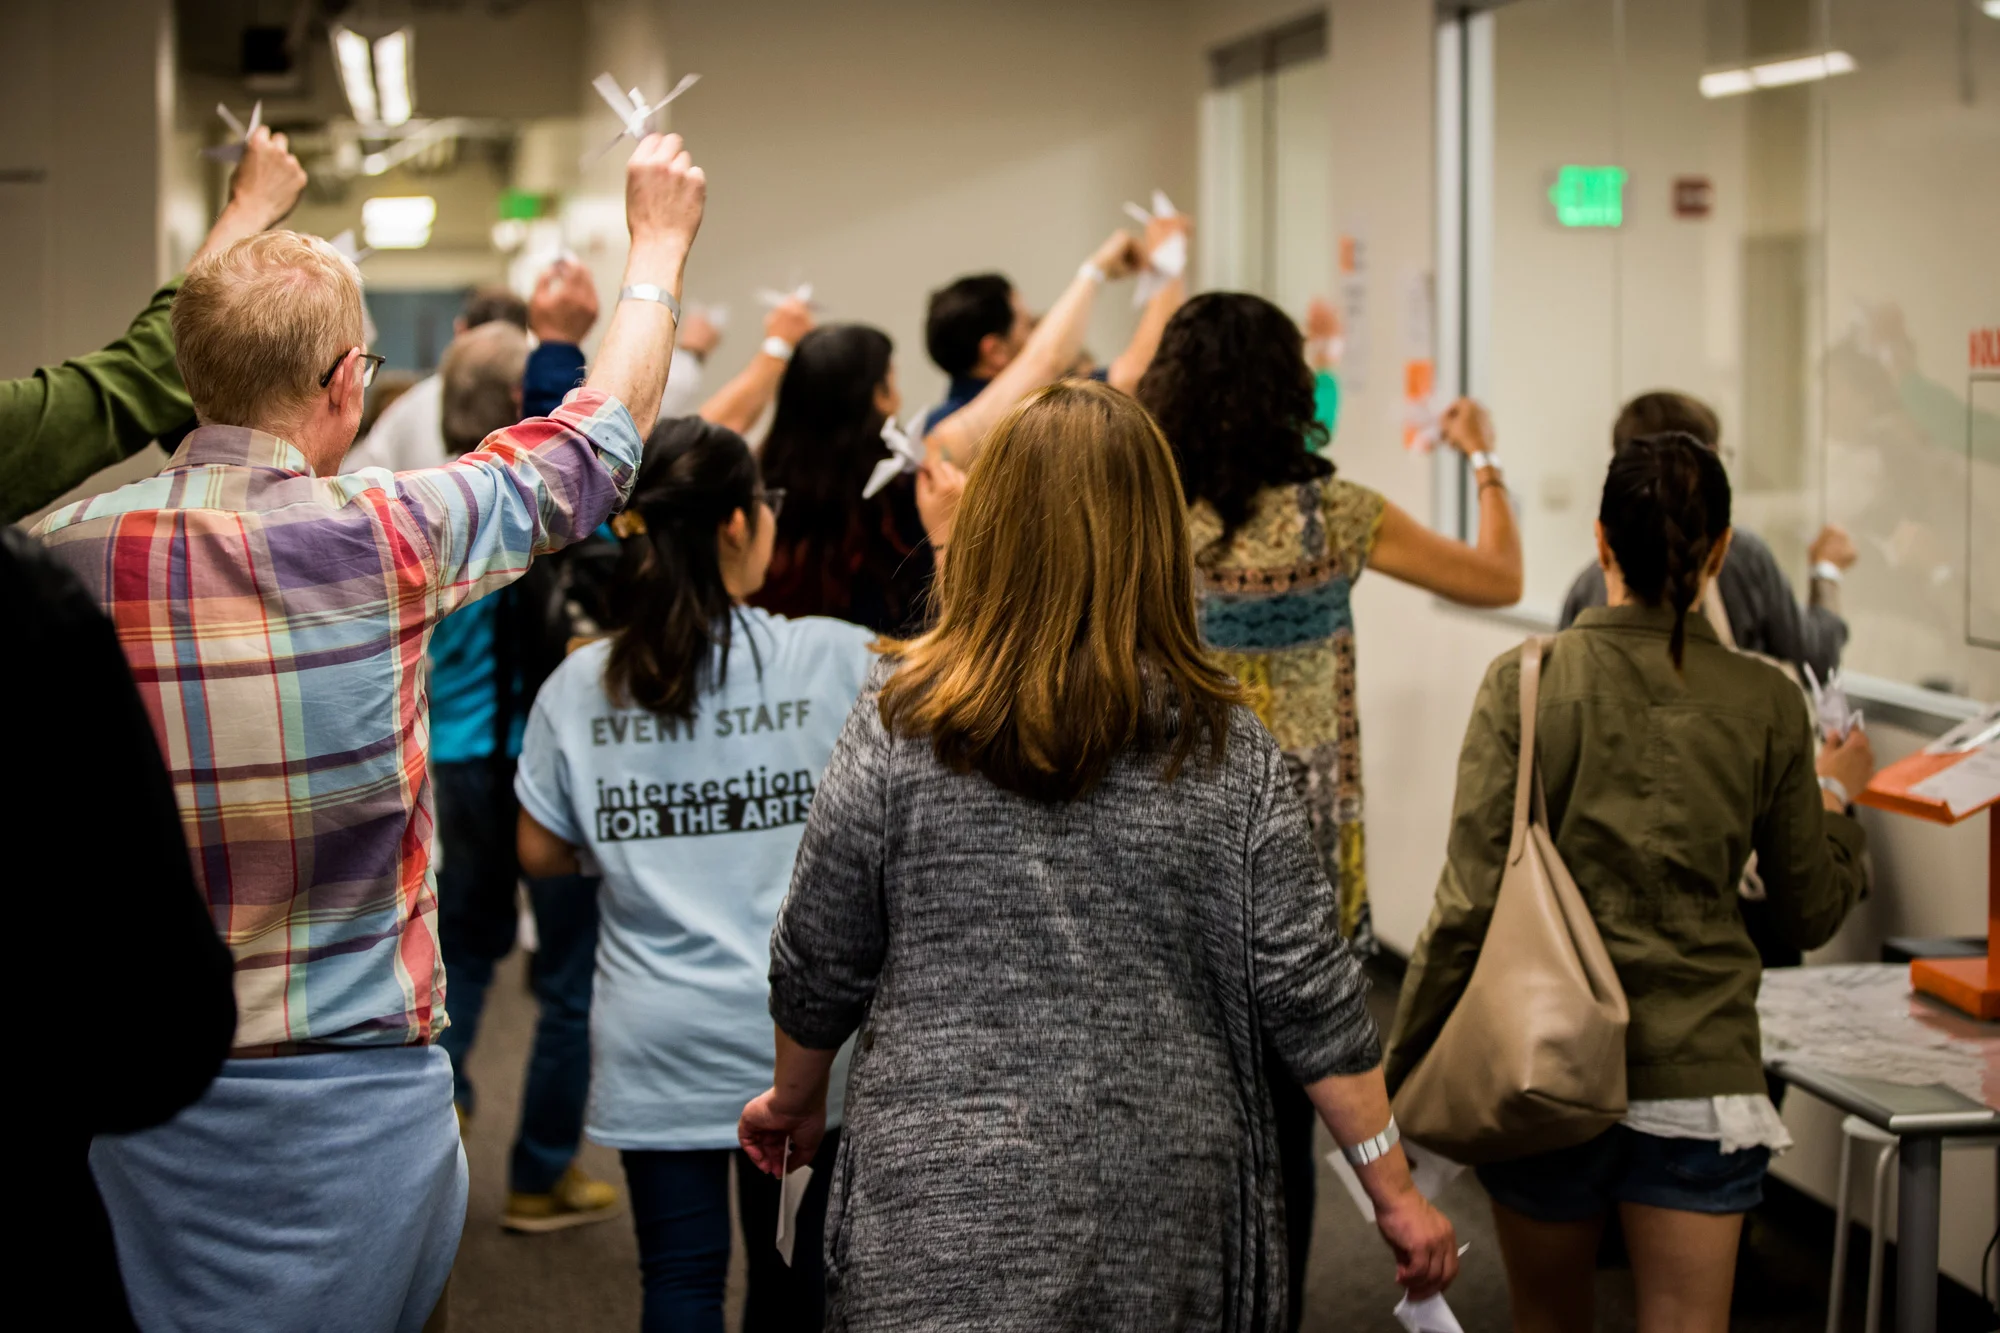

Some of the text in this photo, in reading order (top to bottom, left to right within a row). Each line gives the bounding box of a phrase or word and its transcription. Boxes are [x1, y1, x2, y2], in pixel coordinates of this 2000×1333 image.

[715, 700, 811, 737] STAFF
[597, 765, 814, 808] intersection
[600, 793, 813, 840] FOR THE ARTS
